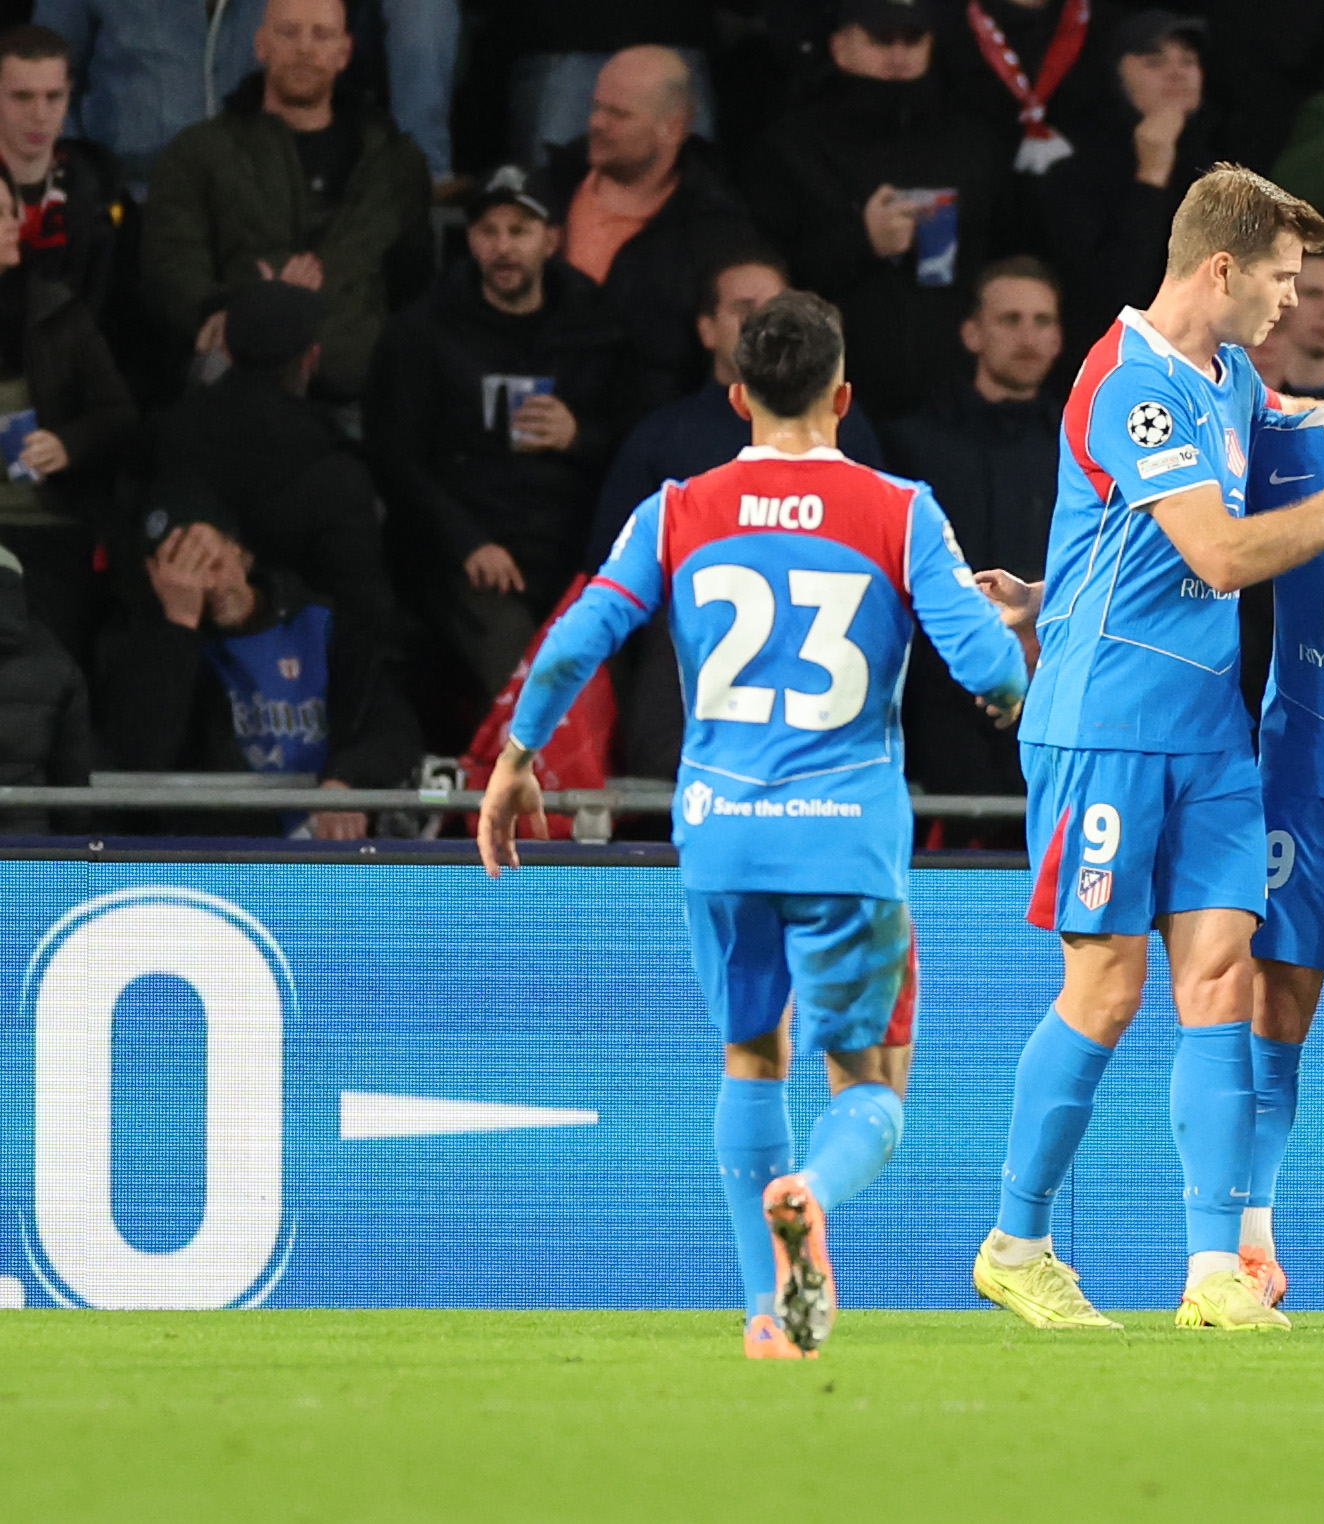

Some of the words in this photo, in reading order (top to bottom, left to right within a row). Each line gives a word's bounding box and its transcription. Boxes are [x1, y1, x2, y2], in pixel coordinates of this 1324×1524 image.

[738, 494, 824, 530] NICO
[692, 564, 872, 731] 23
[713, 796, 752, 815] Save
[755, 799, 784, 817] the
[785, 799, 862, 817] Children
[1082, 803, 1121, 864] 9
[1267, 830, 1296, 889] 9
